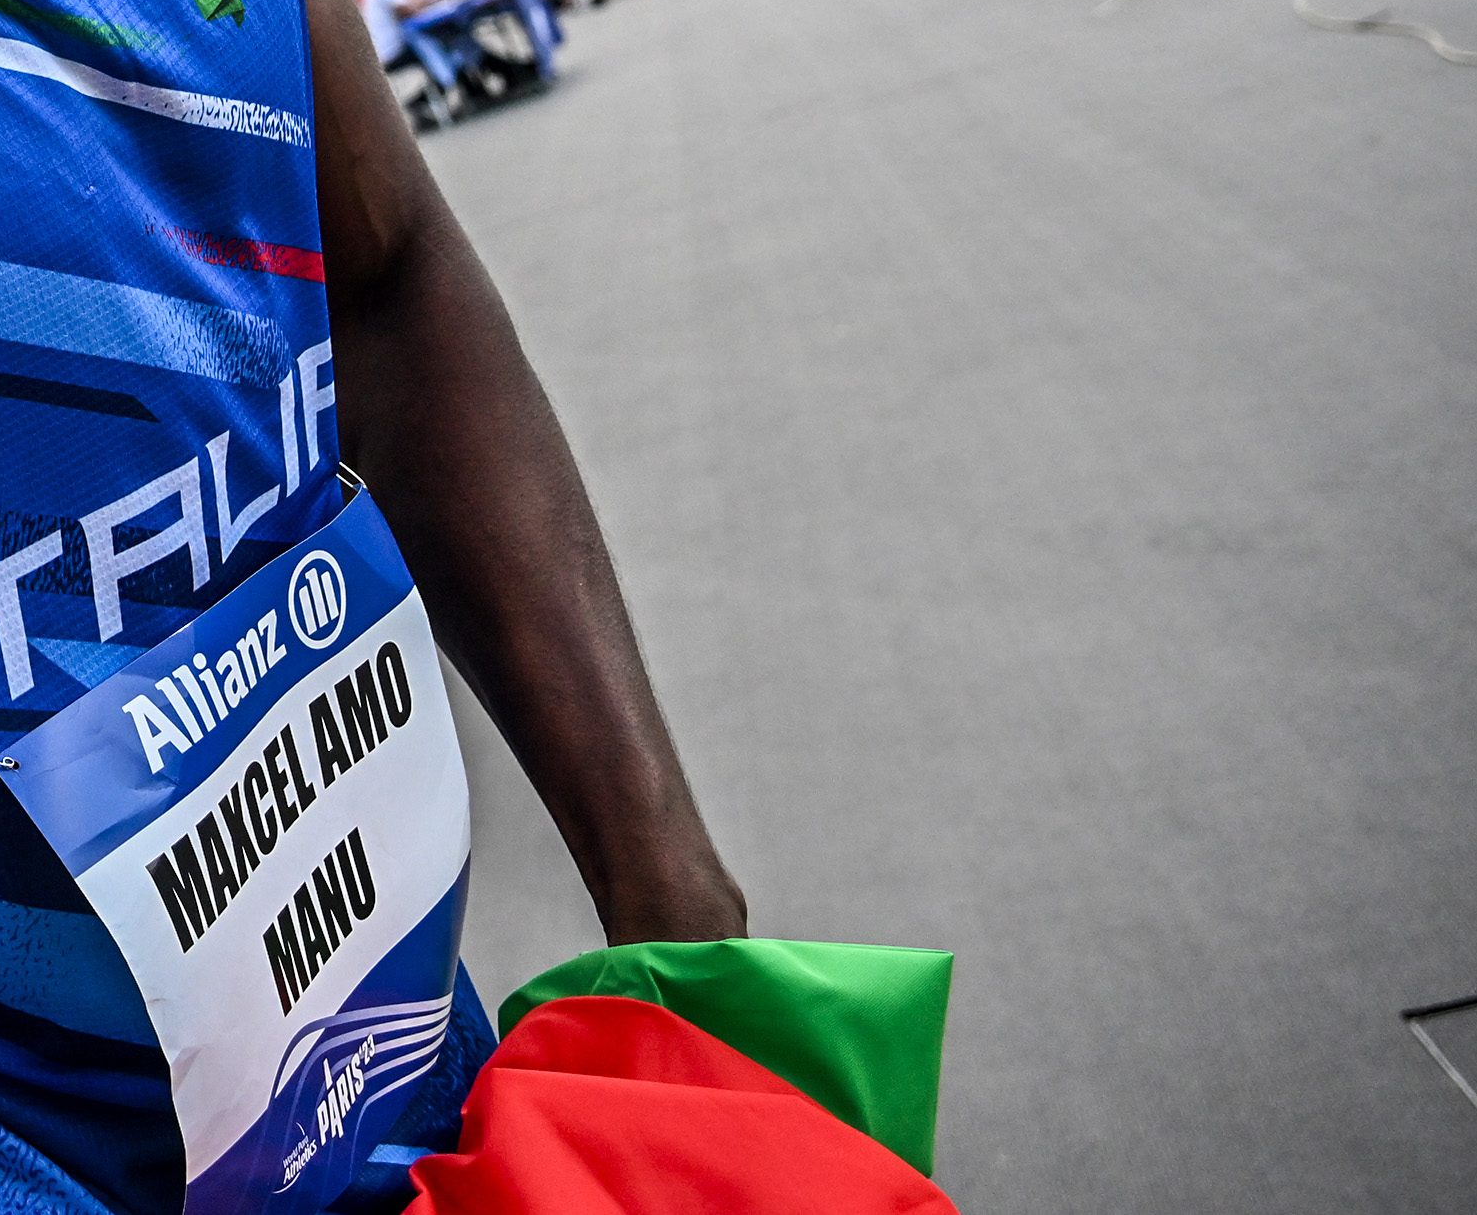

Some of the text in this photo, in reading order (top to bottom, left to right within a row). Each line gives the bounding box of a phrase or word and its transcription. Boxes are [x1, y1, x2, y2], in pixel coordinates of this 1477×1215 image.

[121, 608, 288, 775] Allianz
[144, 641, 412, 954] MAXCEL AMO
[262, 826, 376, 1018] MANU
[283, 1139, 318, 1185] Athletics
